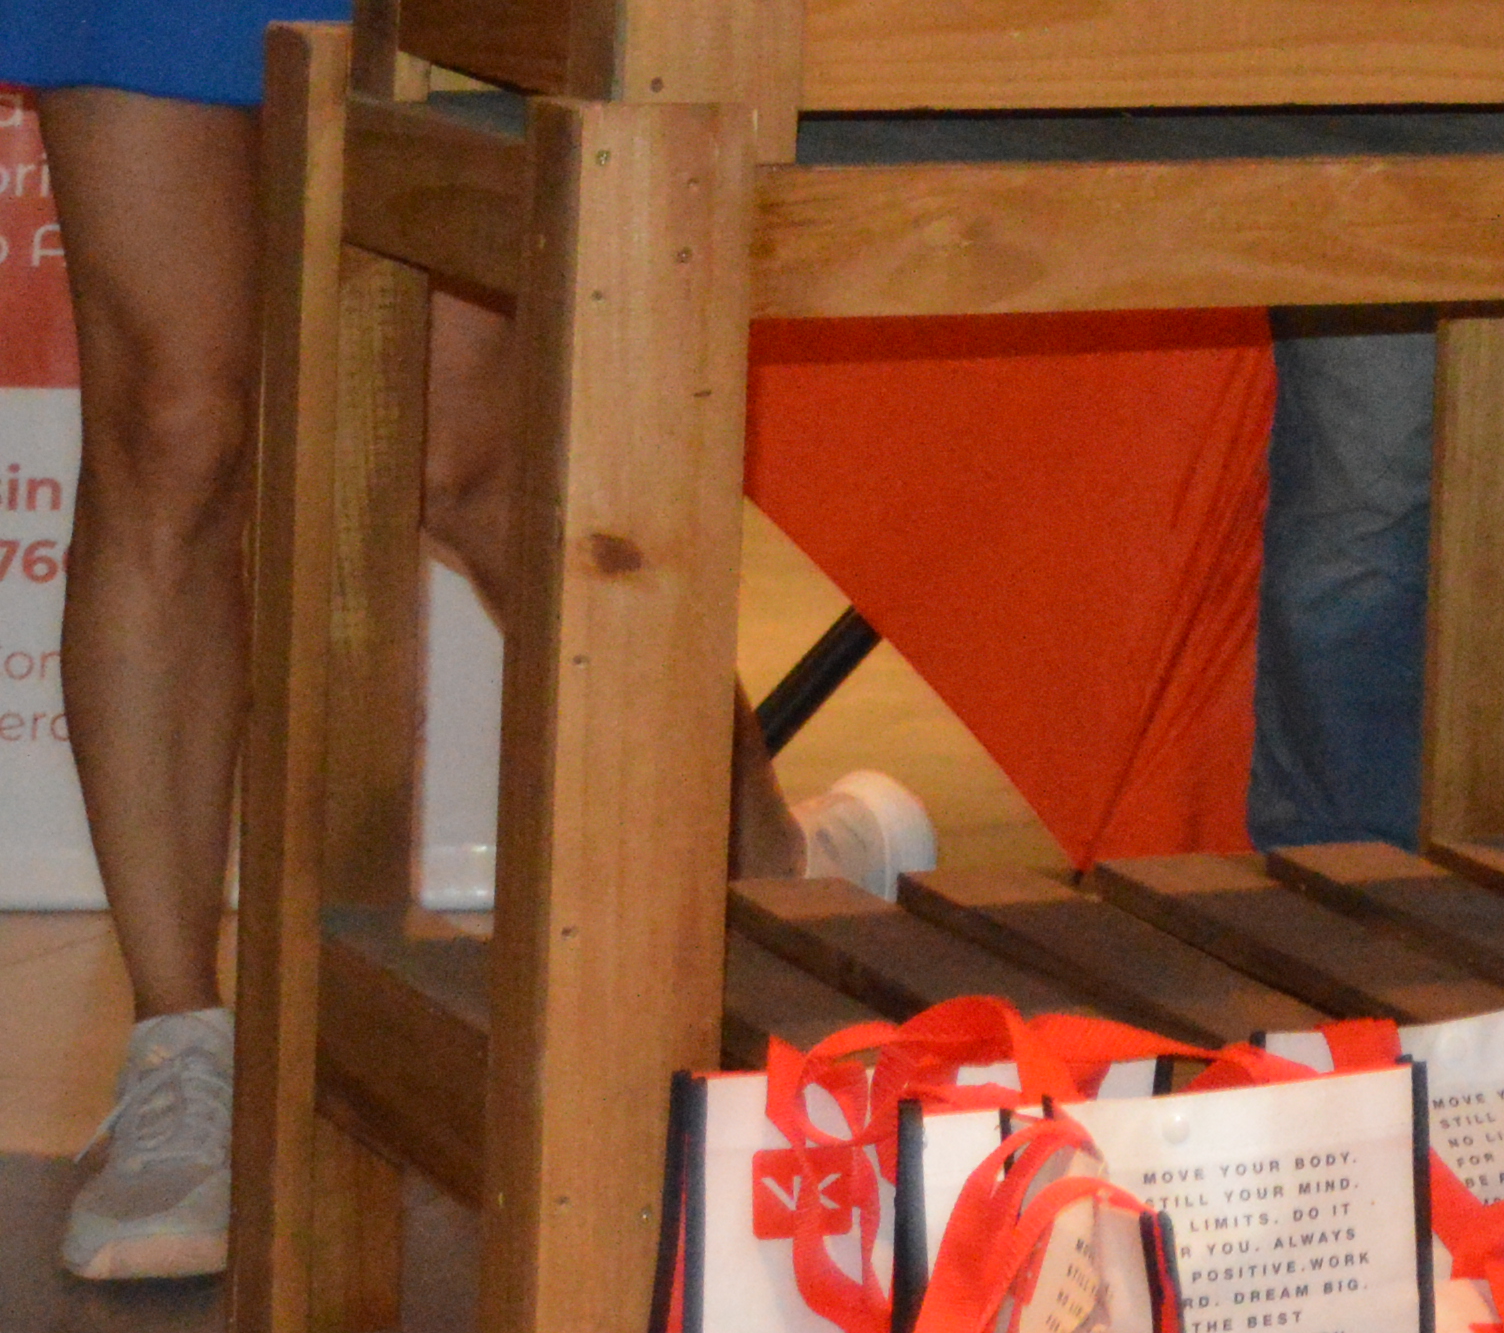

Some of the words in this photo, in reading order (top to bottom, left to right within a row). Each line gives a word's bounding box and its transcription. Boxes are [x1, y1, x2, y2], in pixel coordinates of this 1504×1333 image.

[1142, 1167, 1206, 1186] MOVE
[1219, 1159, 1282, 1178] YOUR
[1294, 1151, 1357, 1171] BODY.
[1206, 1240, 1260, 1256] YOU.
[1273, 1227, 1356, 1251] ALWAYS
